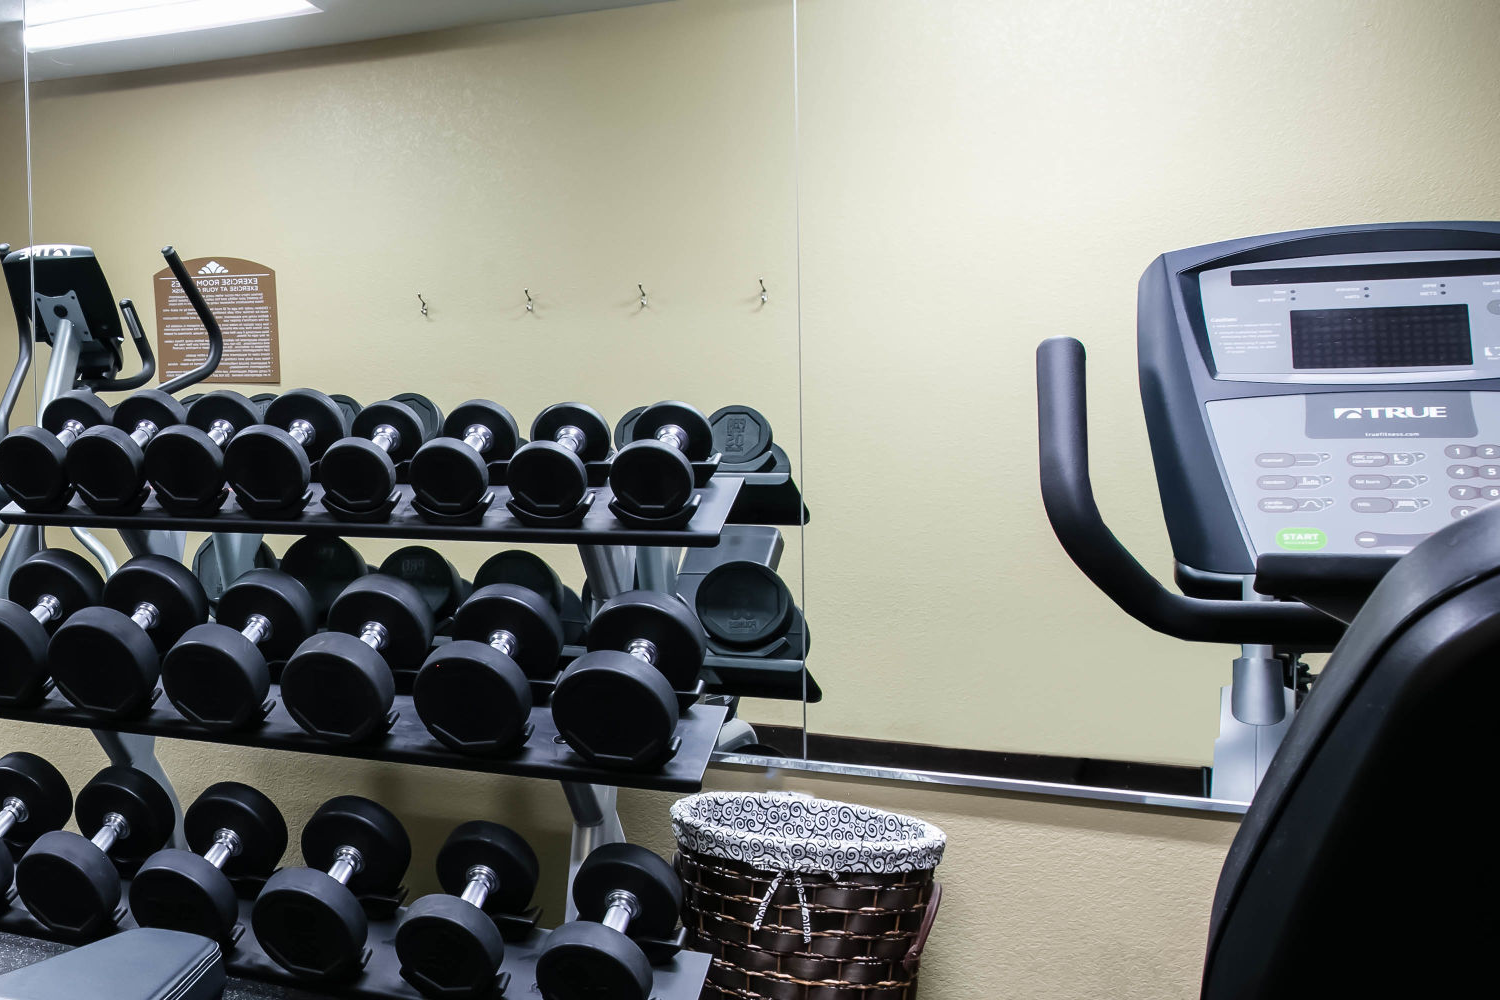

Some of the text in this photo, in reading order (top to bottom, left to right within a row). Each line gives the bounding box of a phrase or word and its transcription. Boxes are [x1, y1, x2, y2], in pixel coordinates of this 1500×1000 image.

[1363, 406, 1447, 419] TRUE
[1454, 447, 1461, 456] 1
[1485, 448, 1494, 456] 2
[1455, 467, 1465, 476] 4
[1488, 468, 1497, 476] 5
[1457, 488, 1467, 497] 7
[1489, 489, 1499, 497] 8
[1282, 533, 1319, 541] START
